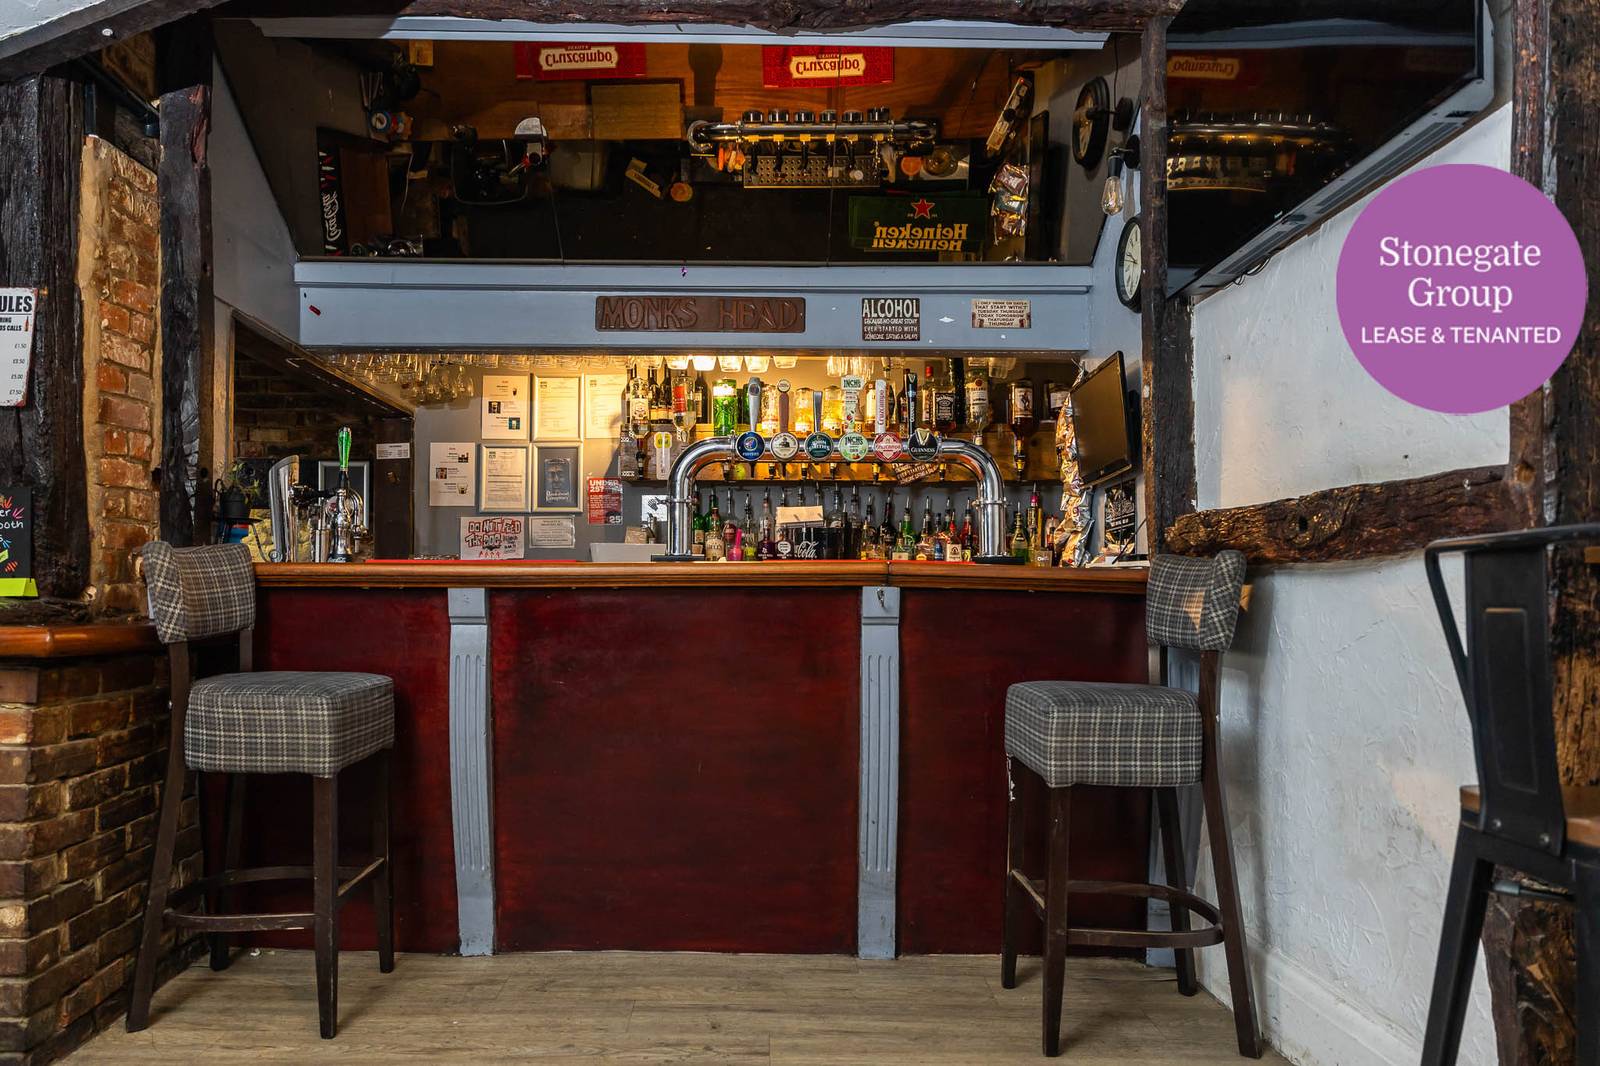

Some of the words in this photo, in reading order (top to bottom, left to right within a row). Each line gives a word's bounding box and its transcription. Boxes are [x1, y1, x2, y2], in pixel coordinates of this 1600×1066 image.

[602, 299, 698, 329] MONKS
[718, 299, 798, 329] HEAD
[863, 299, 919, 318] ALCOHOL
[482, 519, 501, 533] NOT
[502, 518, 521, 534] FEED
[609, 515, 621, 524] 25
